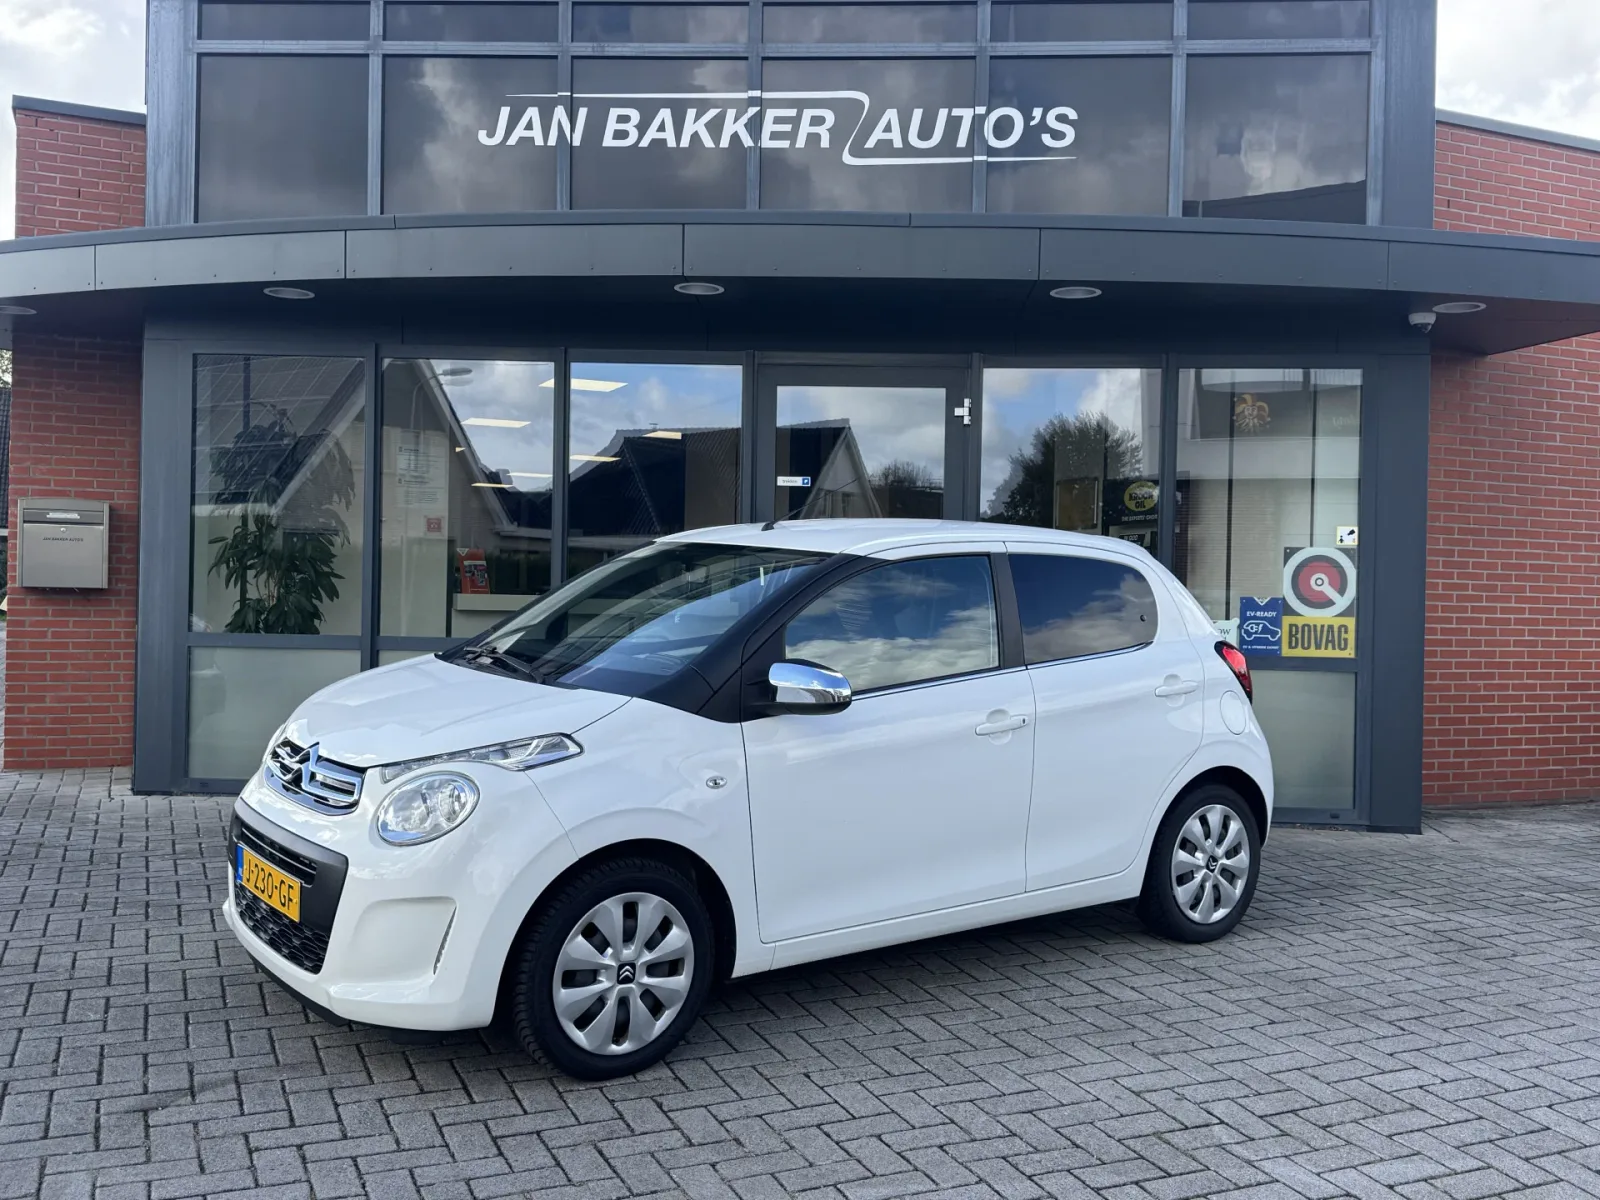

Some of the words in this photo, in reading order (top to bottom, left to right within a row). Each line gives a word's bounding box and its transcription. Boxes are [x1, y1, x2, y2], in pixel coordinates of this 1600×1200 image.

[477, 105, 588, 146] JAN
[602, 106, 836, 149] BAKKER
[863, 106, 1079, 149] AUTO'S
[1134, 500, 1146, 509] OIL
[1288, 623, 1349, 651] BOVAG
[246, 858, 294, 911] J-230-GF
